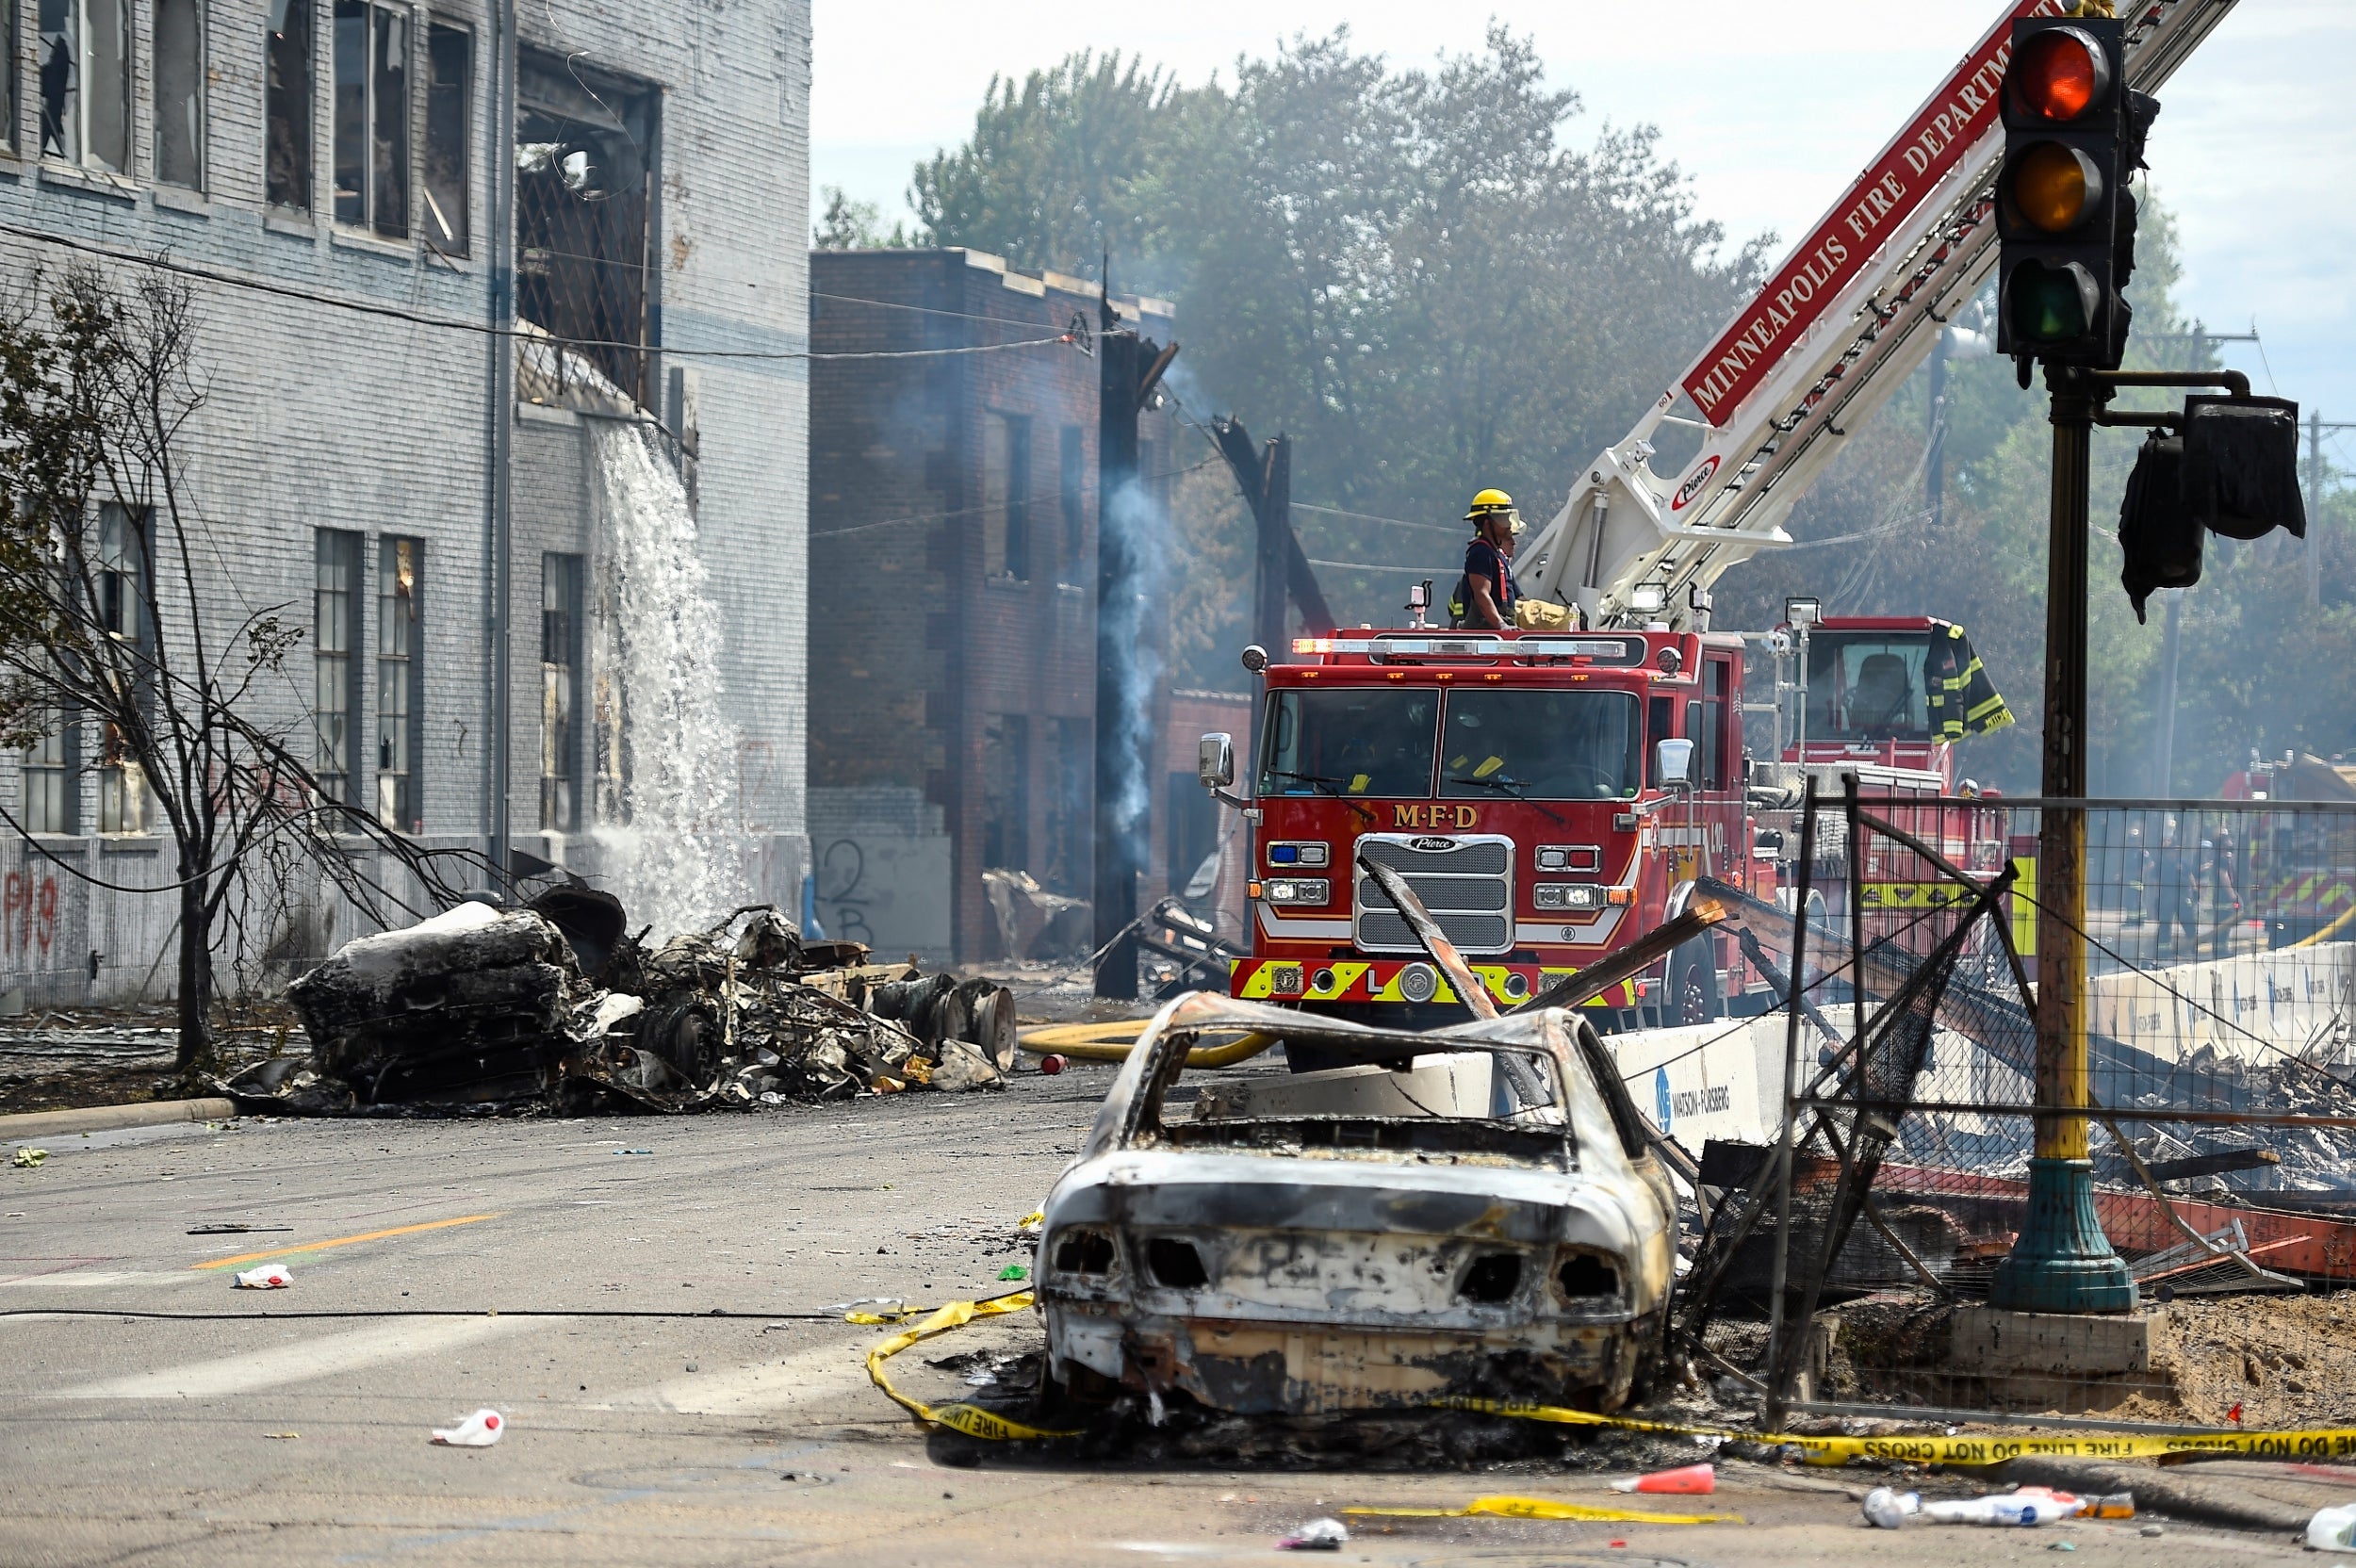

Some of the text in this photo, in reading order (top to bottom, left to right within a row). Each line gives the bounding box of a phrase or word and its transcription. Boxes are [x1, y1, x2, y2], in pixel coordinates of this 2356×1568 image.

[1693, 0, 2053, 414] MINNEAPOLIS FIRE DEPARTMT
[1682, 466, 1710, 501] Pierce
[1415, 838, 1450, 849] Pierce
[1367, 970, 1383, 993] L
[973, 1413, 1009, 1439] FIRE
[1864, 1441, 1933, 1458] CROSS
[1944, 1442, 1986, 1462] NOT
[1992, 1443, 2021, 1460] DO
[2085, 1442, 2134, 1456] FIRE
[2299, 1436, 2329, 1456] DO
